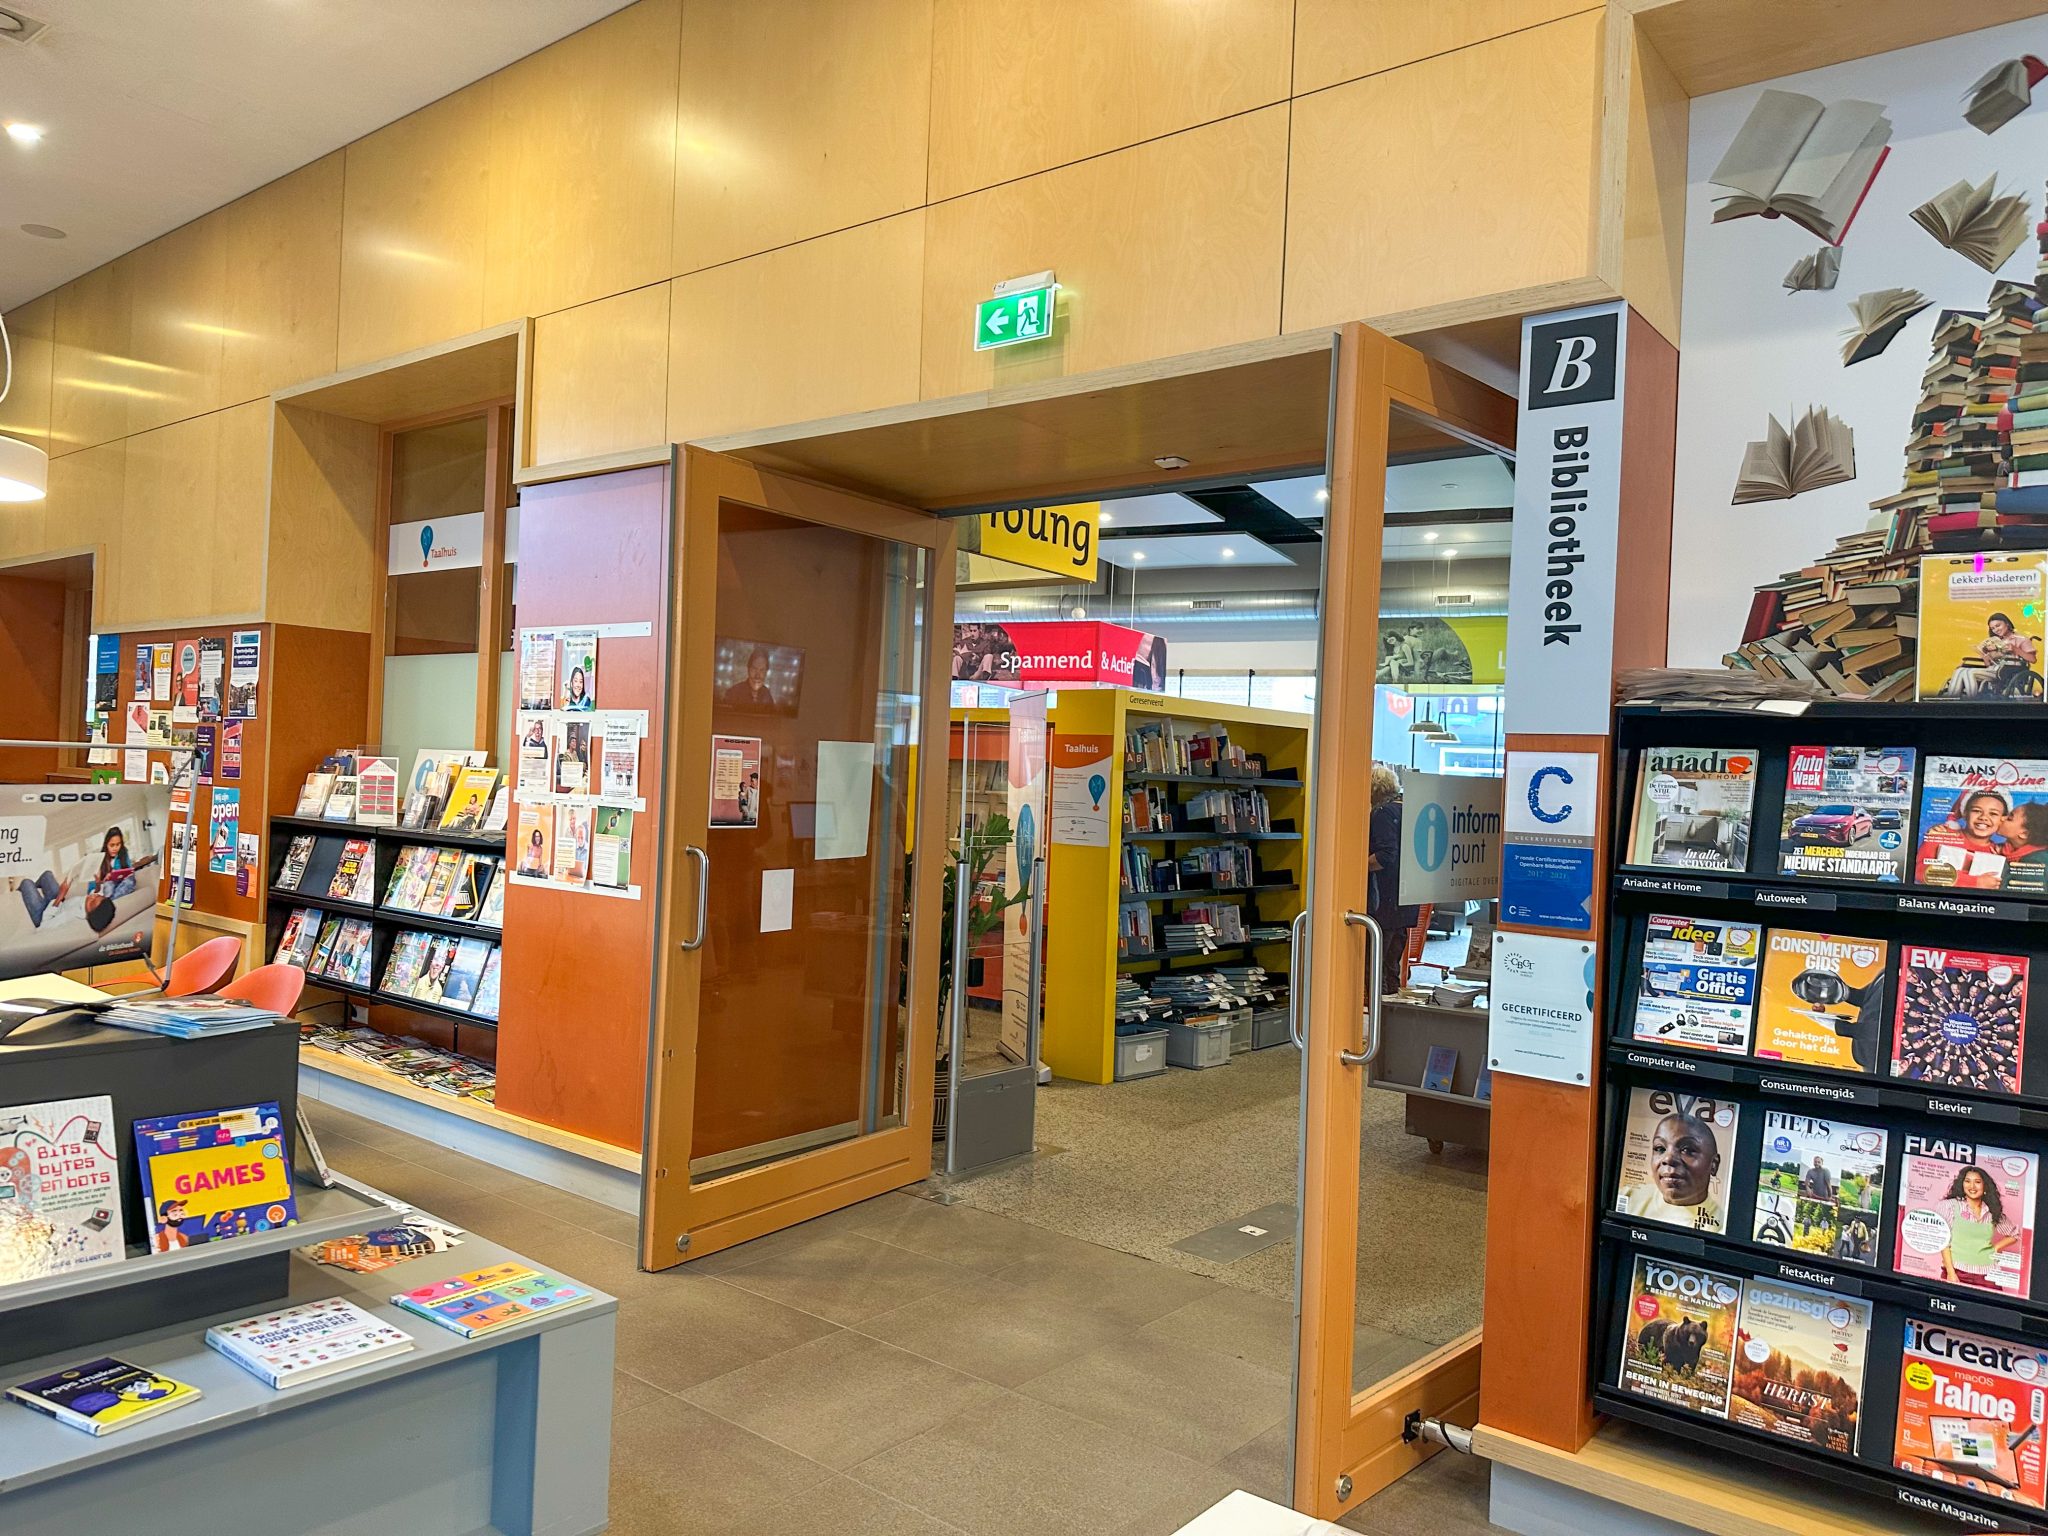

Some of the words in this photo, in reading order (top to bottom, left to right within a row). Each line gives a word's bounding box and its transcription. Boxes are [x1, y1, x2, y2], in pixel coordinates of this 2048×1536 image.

[1543, 335, 1598, 394] B
[1544, 426, 1589, 646] Bibliotheek
[431, 547, 457, 559] Taalhuis
[1952, 574, 1984, 585] Lekker
[1986, 572, 2037, 584] bladeren!
[1000, 649, 1093, 673] Spannend
[1101, 652, 1110, 669] &
[1111, 655, 1136, 675] Actief
[1065, 744, 1099, 753] Taalhuis
[1792, 755, 1823, 772] Auto
[1938, 763, 1996, 776] BALANS
[1792, 771, 1821, 786] Week
[1960, 773, 2046, 791] Magine
[1528, 766, 1574, 824] C
[212, 802, 240, 823] open
[1452, 804, 1500, 834] inform
[1514, 835, 1583, 845] GECERTIFICEERD
[1451, 841, 1486, 872] punt
[1685, 848, 1698, 859] In
[1700, 849, 1720, 860] alle
[1793, 847, 1804, 856] ZET
[1804, 846, 1845, 857] MERCEDES
[1879, 851, 1890, 860] EEN
[1679, 858, 1729, 869] eenvoud
[1784, 856, 1825, 872] NIEUWE
[1827, 858, 1898, 875] STANDAARD?
[1451, 878, 1480, 887] DIGITALE
[1623, 878, 1660, 890] Ariadne
[1661, 882, 1672, 890] at
[1673, 881, 1702, 893] Home
[1756, 892, 1808, 904] Autoweek
[1899, 897, 1936, 909] Balans
[1938, 900, 1996, 914] Magazine
[1652, 916, 1689, 927] Computer
[1805, 954, 1840, 972] GIDS
[1910, 949, 1947, 970] EW
[1697, 968, 1747, 985] Gratis
[1696, 980, 1745, 997] Office
[1502, 1003, 1582, 1022] GECERTIFICEERD
[1773, 1027, 1836, 1045] Gehaktprijs
[1772, 1037, 1798, 1049] door
[1800, 1042, 1818, 1052] het
[1820, 1044, 1840, 1055] dak
[1628, 1053, 1675, 1068] Computer
[1676, 1061, 1696, 1072] Idee
[1761, 1079, 1855, 1099] Consumentengids
[1649, 1091, 1716, 1123] eva
[1928, 1100, 1973, 1115] Elsevier
[1767, 1112, 1830, 1137] FIETS
[1904, 1135, 1973, 1163] FLAIR
[175, 1162, 266, 1195] GAMES
[1697, 1206, 1709, 1217] Ik
[1909, 1214, 1929, 1224] Real
[1698, 1216, 1720, 1227] mis
[1631, 1230, 1648, 1241] Eva
[1780, 1264, 1835, 1286] FietsActief
[1651, 1288, 1677, 1298] BELEEF
[1690, 1296, 1722, 1310] NATUUR
[1750, 1287, 1854, 1324] gezinsgi
[1930, 1298, 1956, 1313] Flair
[42, 1380, 79, 1397] Apps
[80, 1365, 128, 1383] maken
[1626, 1370, 1657, 1386] BEREN
[1659, 1380, 1670, 1390] IN
[1671, 1384, 1723, 1405] BEWEGING
[1954, 1370, 1994, 1387] macOS
[1763, 1381, 1832, 1410] HERFST
[1933, 1374, 2016, 1423] Tahoe
[1899, 1490, 1939, 1511] iCreate
[1940, 1503, 1999, 1528] Magazine
